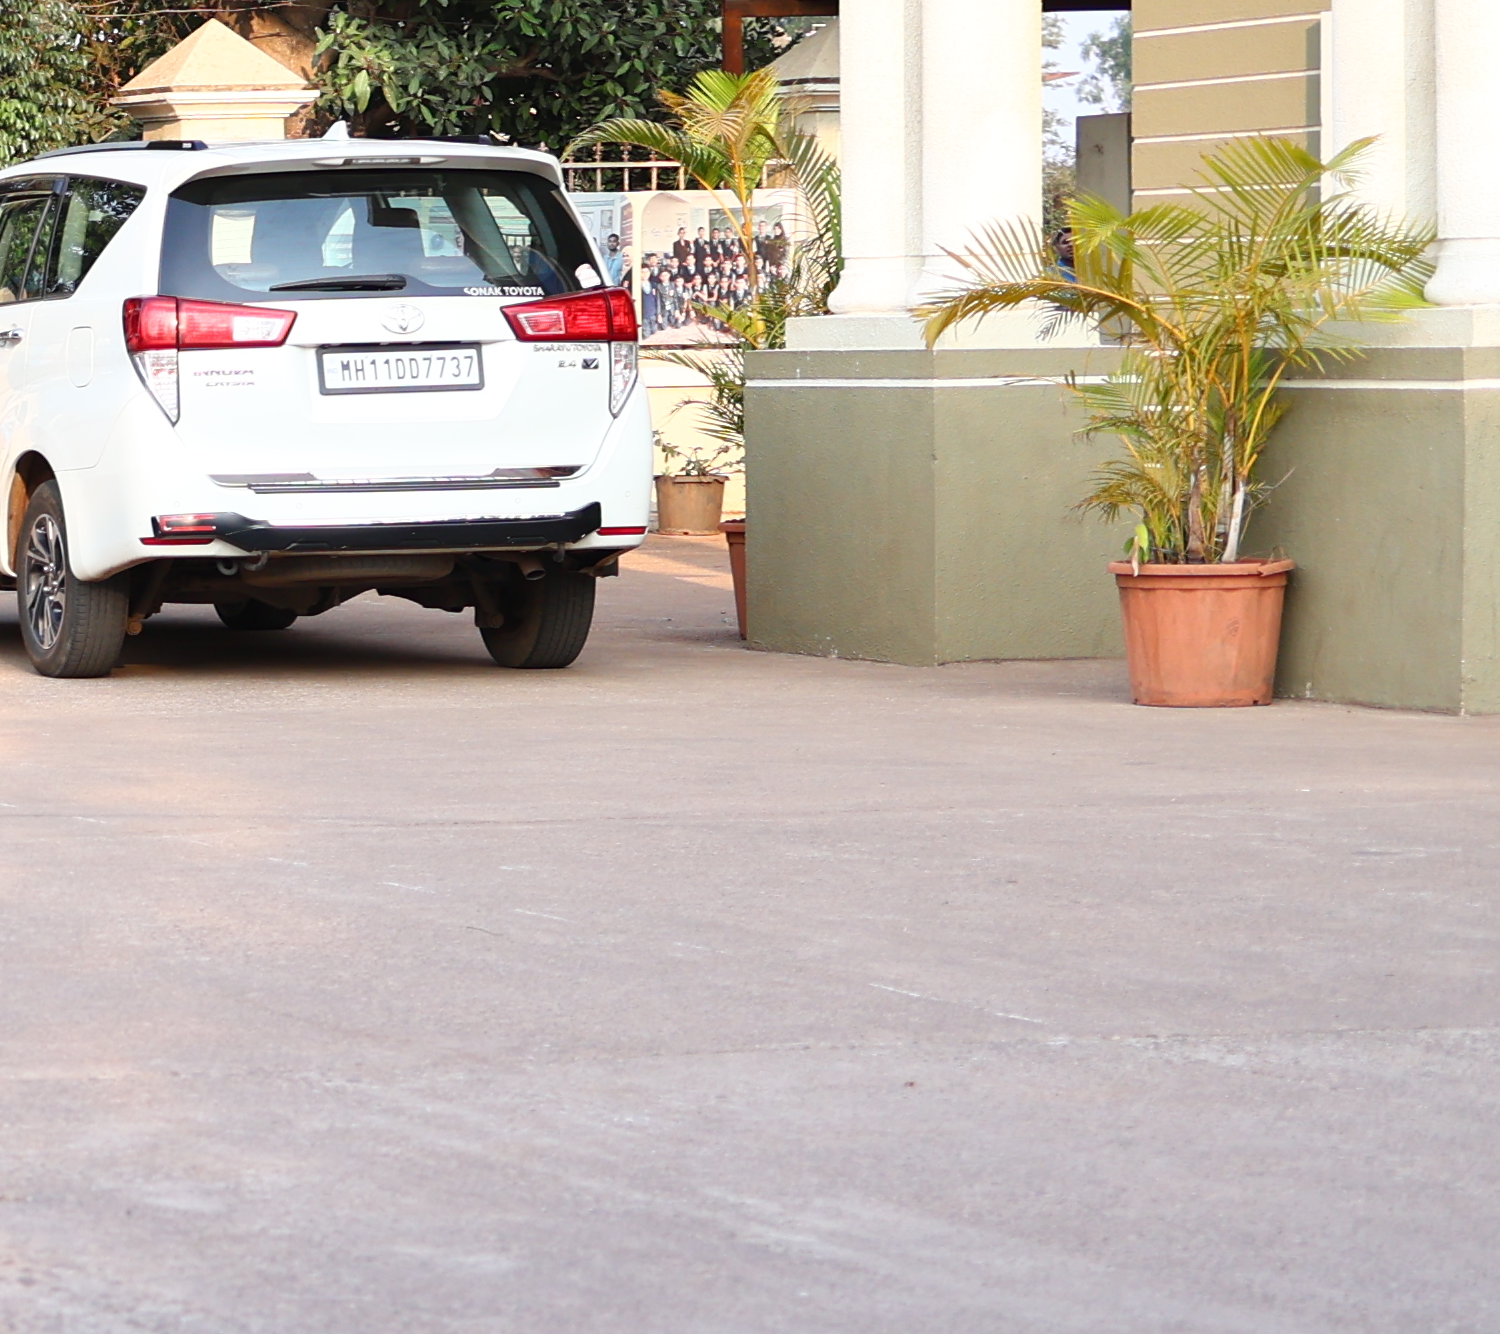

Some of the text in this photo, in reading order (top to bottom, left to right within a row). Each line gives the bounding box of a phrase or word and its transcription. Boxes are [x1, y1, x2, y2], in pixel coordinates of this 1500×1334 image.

[463, 286, 544, 296] SONAK TOYOTA
[340, 355, 474, 381] MH11DD7737
